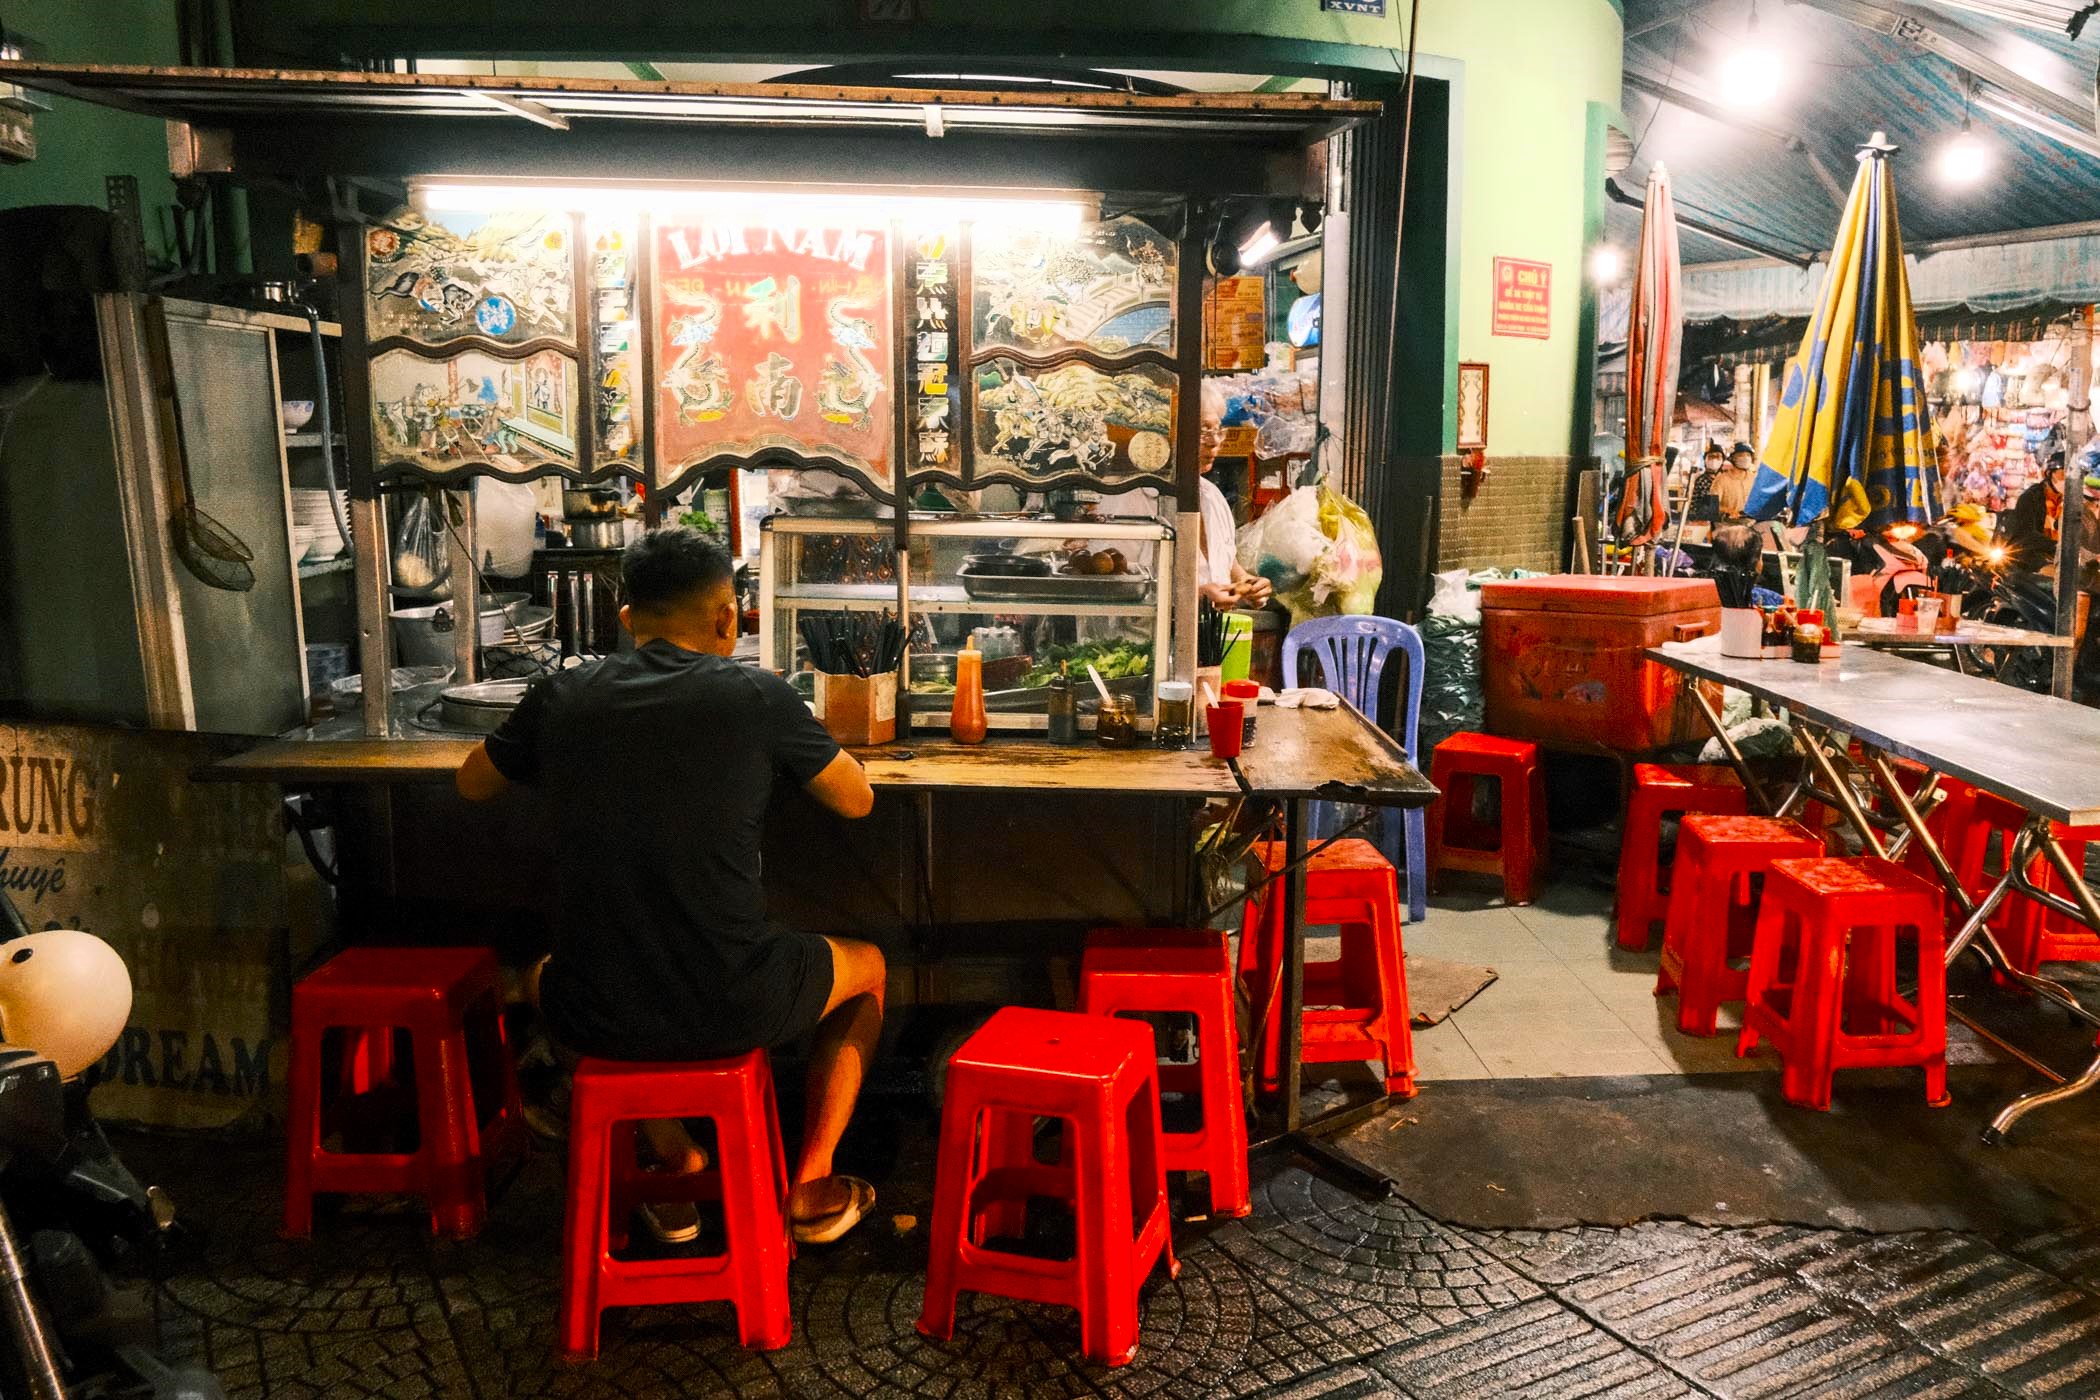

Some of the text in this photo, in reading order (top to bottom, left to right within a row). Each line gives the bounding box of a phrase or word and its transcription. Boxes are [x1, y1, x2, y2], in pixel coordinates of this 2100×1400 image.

[1331, 1, 1381, 13] XVNT
[761, 225, 877, 272] NAM
[1518, 269, 1538, 285] CHÚ
